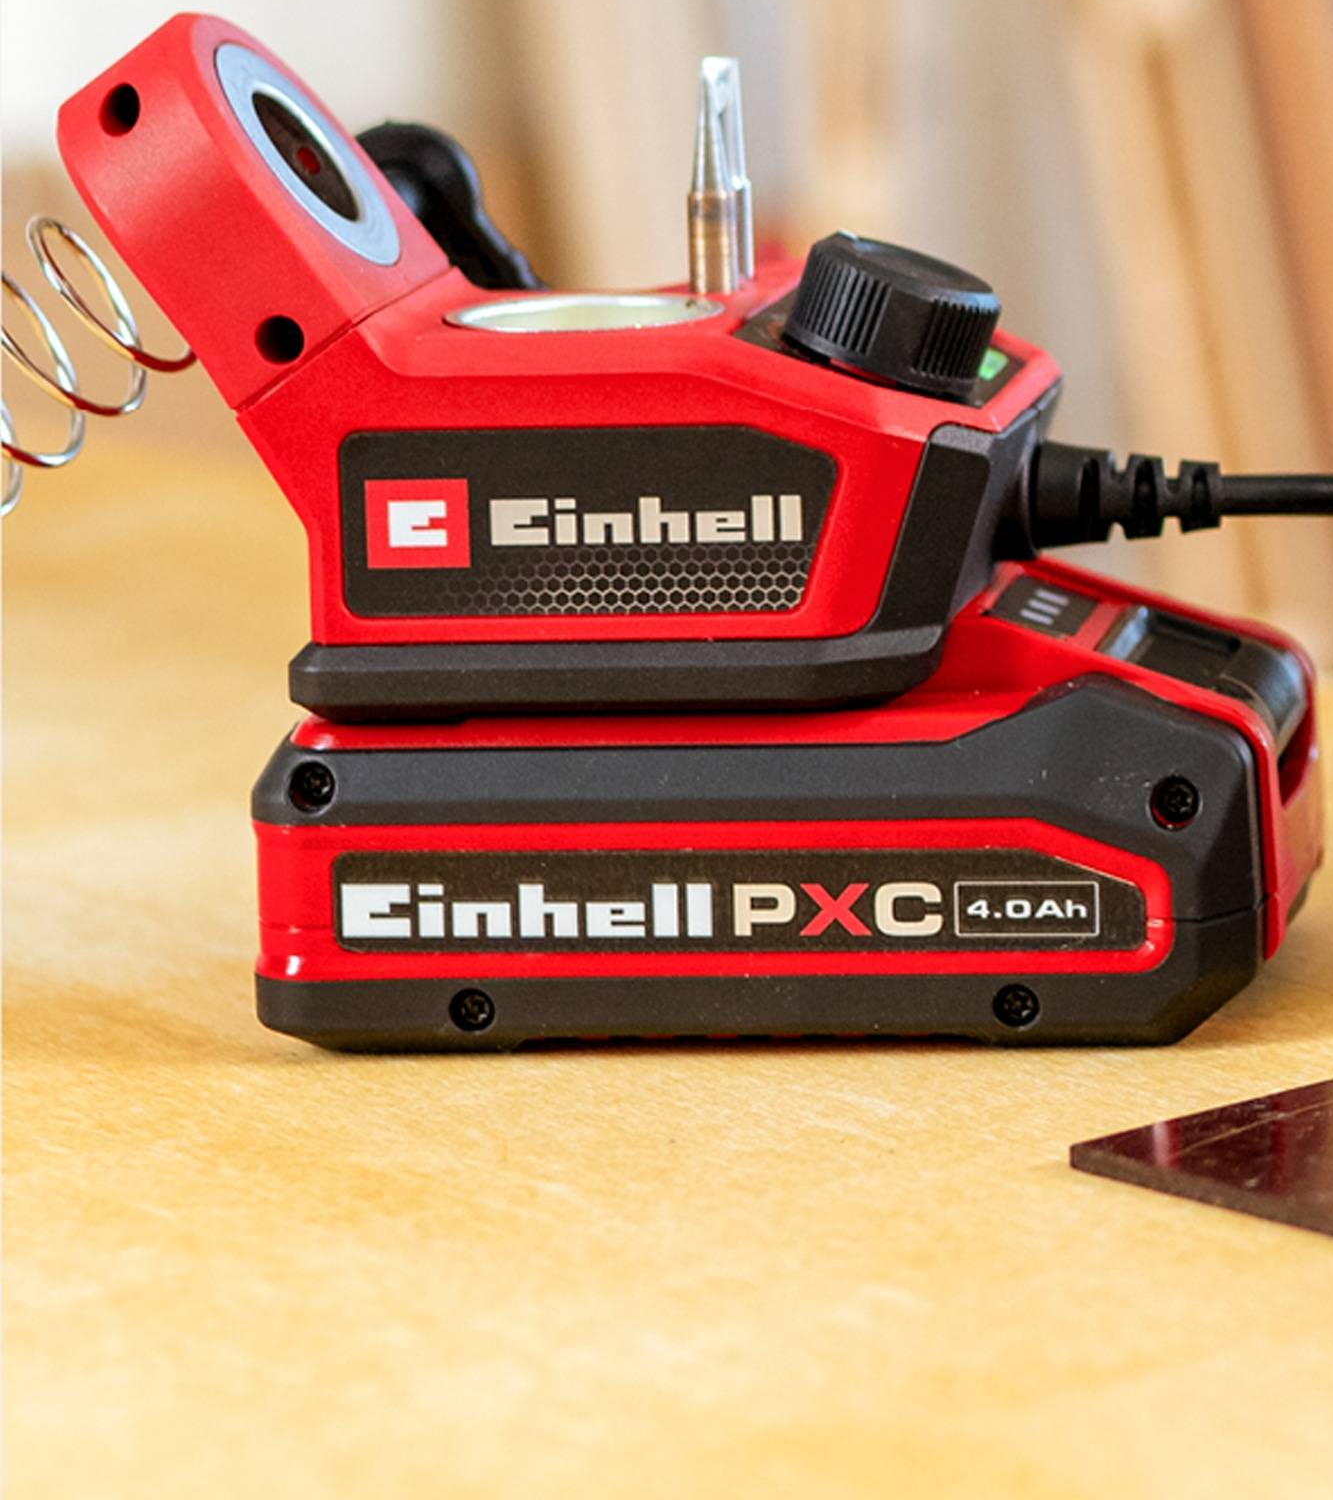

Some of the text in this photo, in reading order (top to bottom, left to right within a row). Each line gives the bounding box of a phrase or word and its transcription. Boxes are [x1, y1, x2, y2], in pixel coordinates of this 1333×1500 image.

[489, 494, 804, 546] Einhell
[340, 881, 1089, 939] Einhell PXC 4.0Ah
